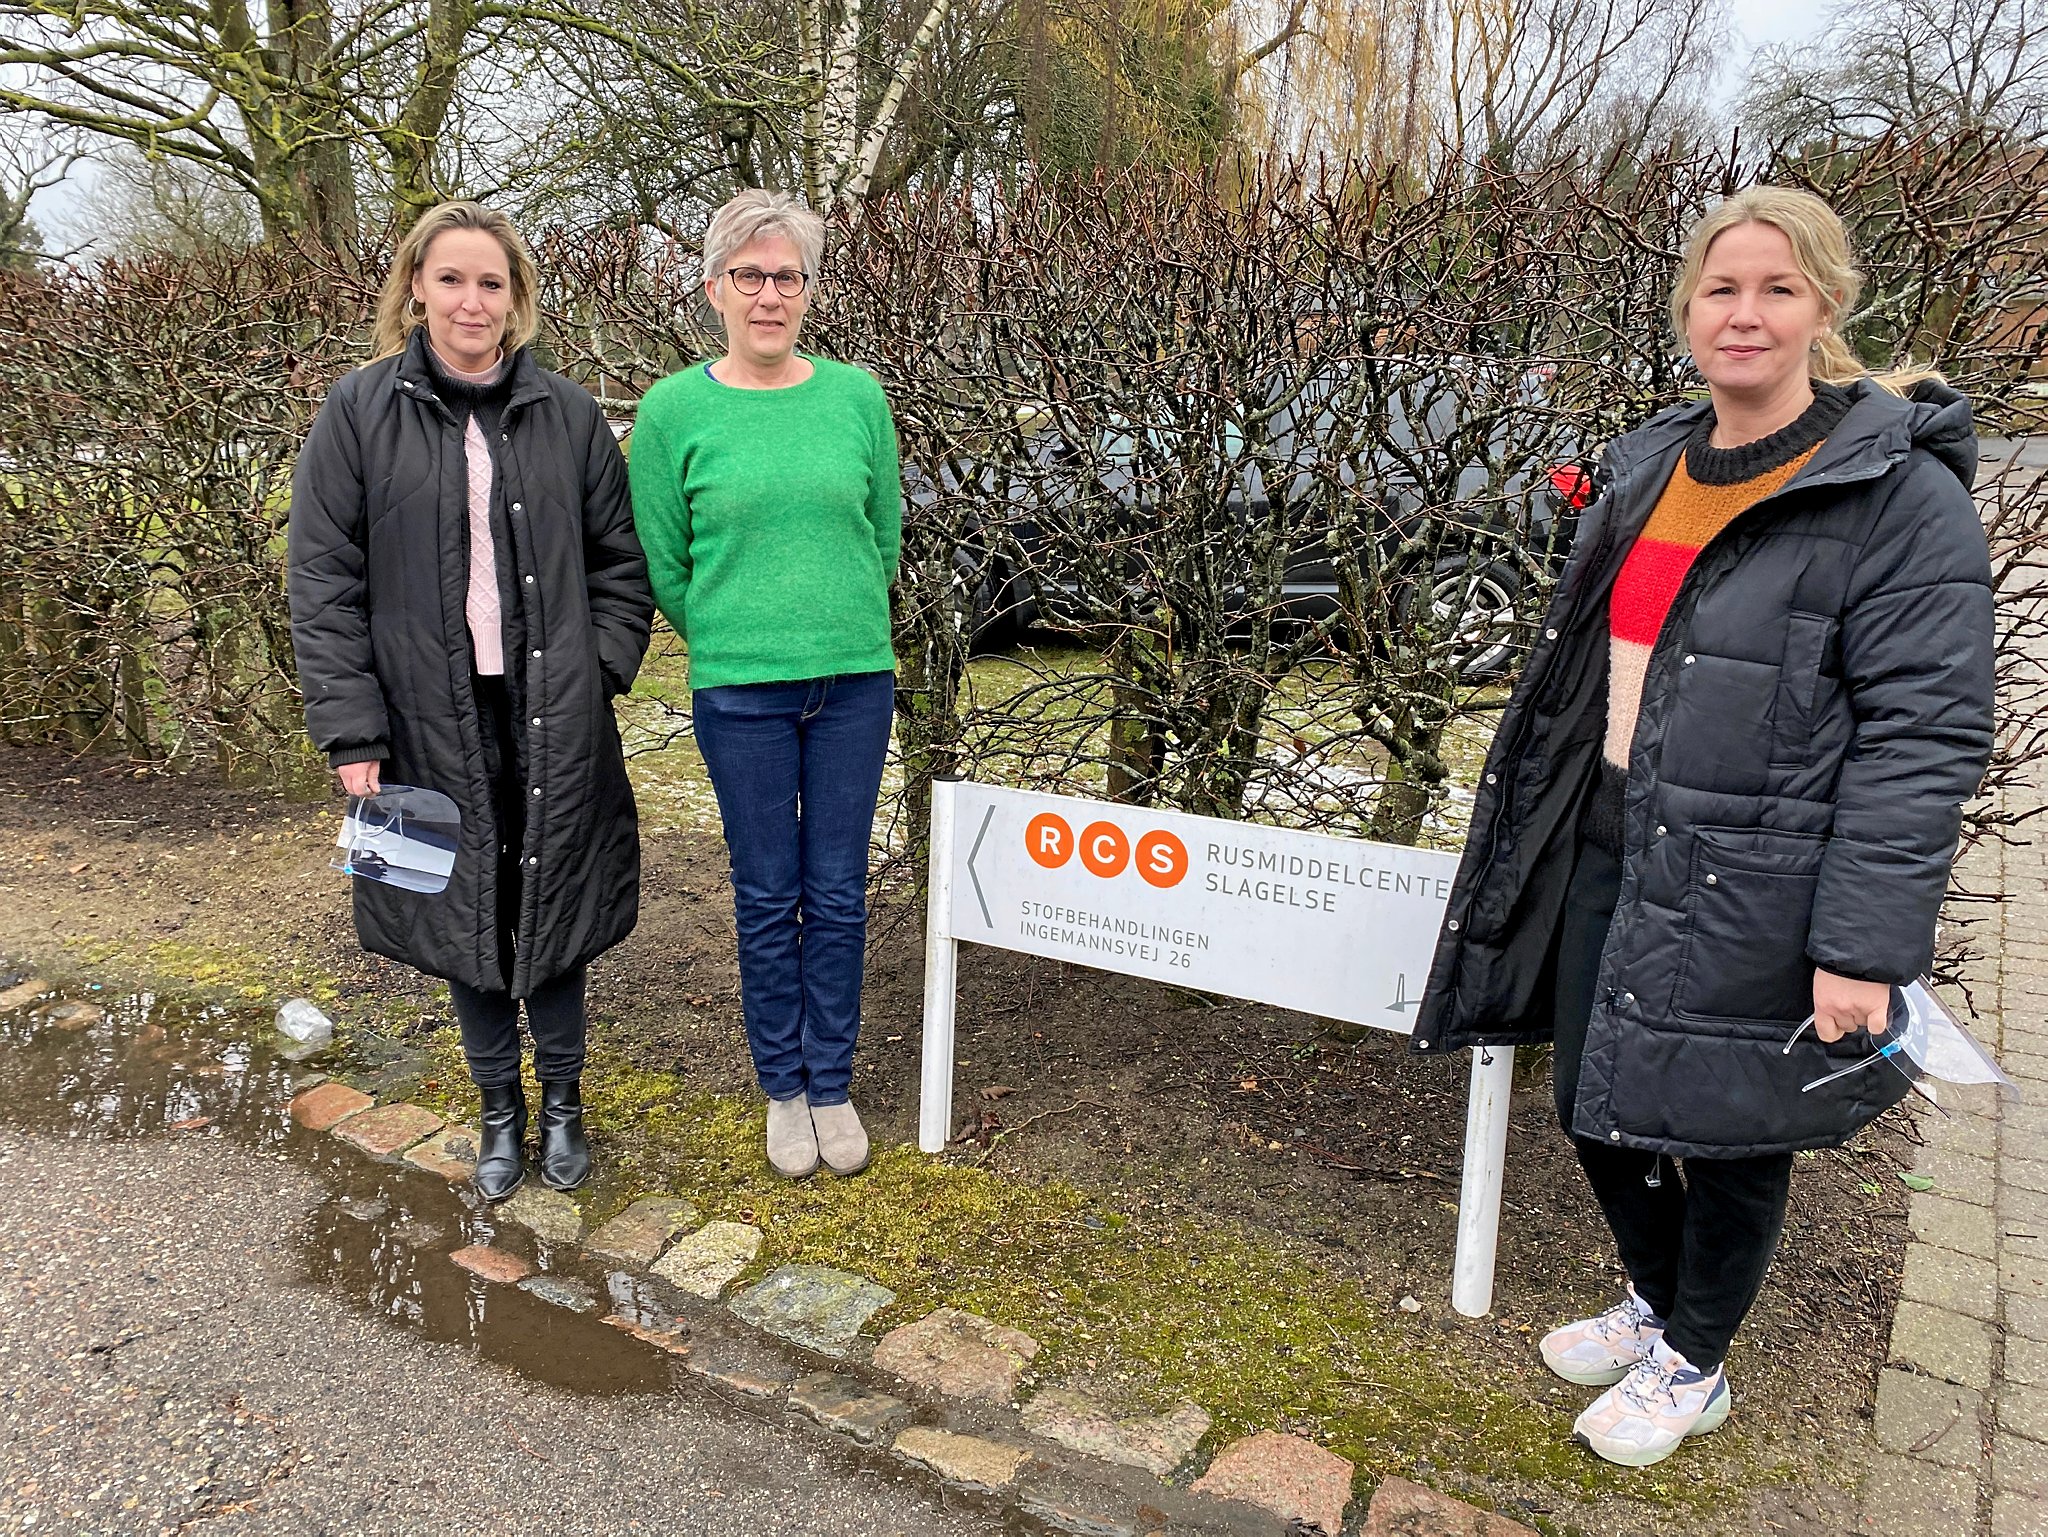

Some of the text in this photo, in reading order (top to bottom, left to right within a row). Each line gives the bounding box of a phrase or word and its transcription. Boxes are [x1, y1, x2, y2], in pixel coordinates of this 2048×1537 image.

[1040, 826, 1175, 873] RCS
[1207, 843, 1449, 900] RUSMIDDELCENTE
[1205, 873, 1336, 912] SLAGELSE
[1020, 921, 1191, 968] INGEMANNSVEJ 26
[1021, 900, 1210, 950] STOFBEHANDLINGEN
